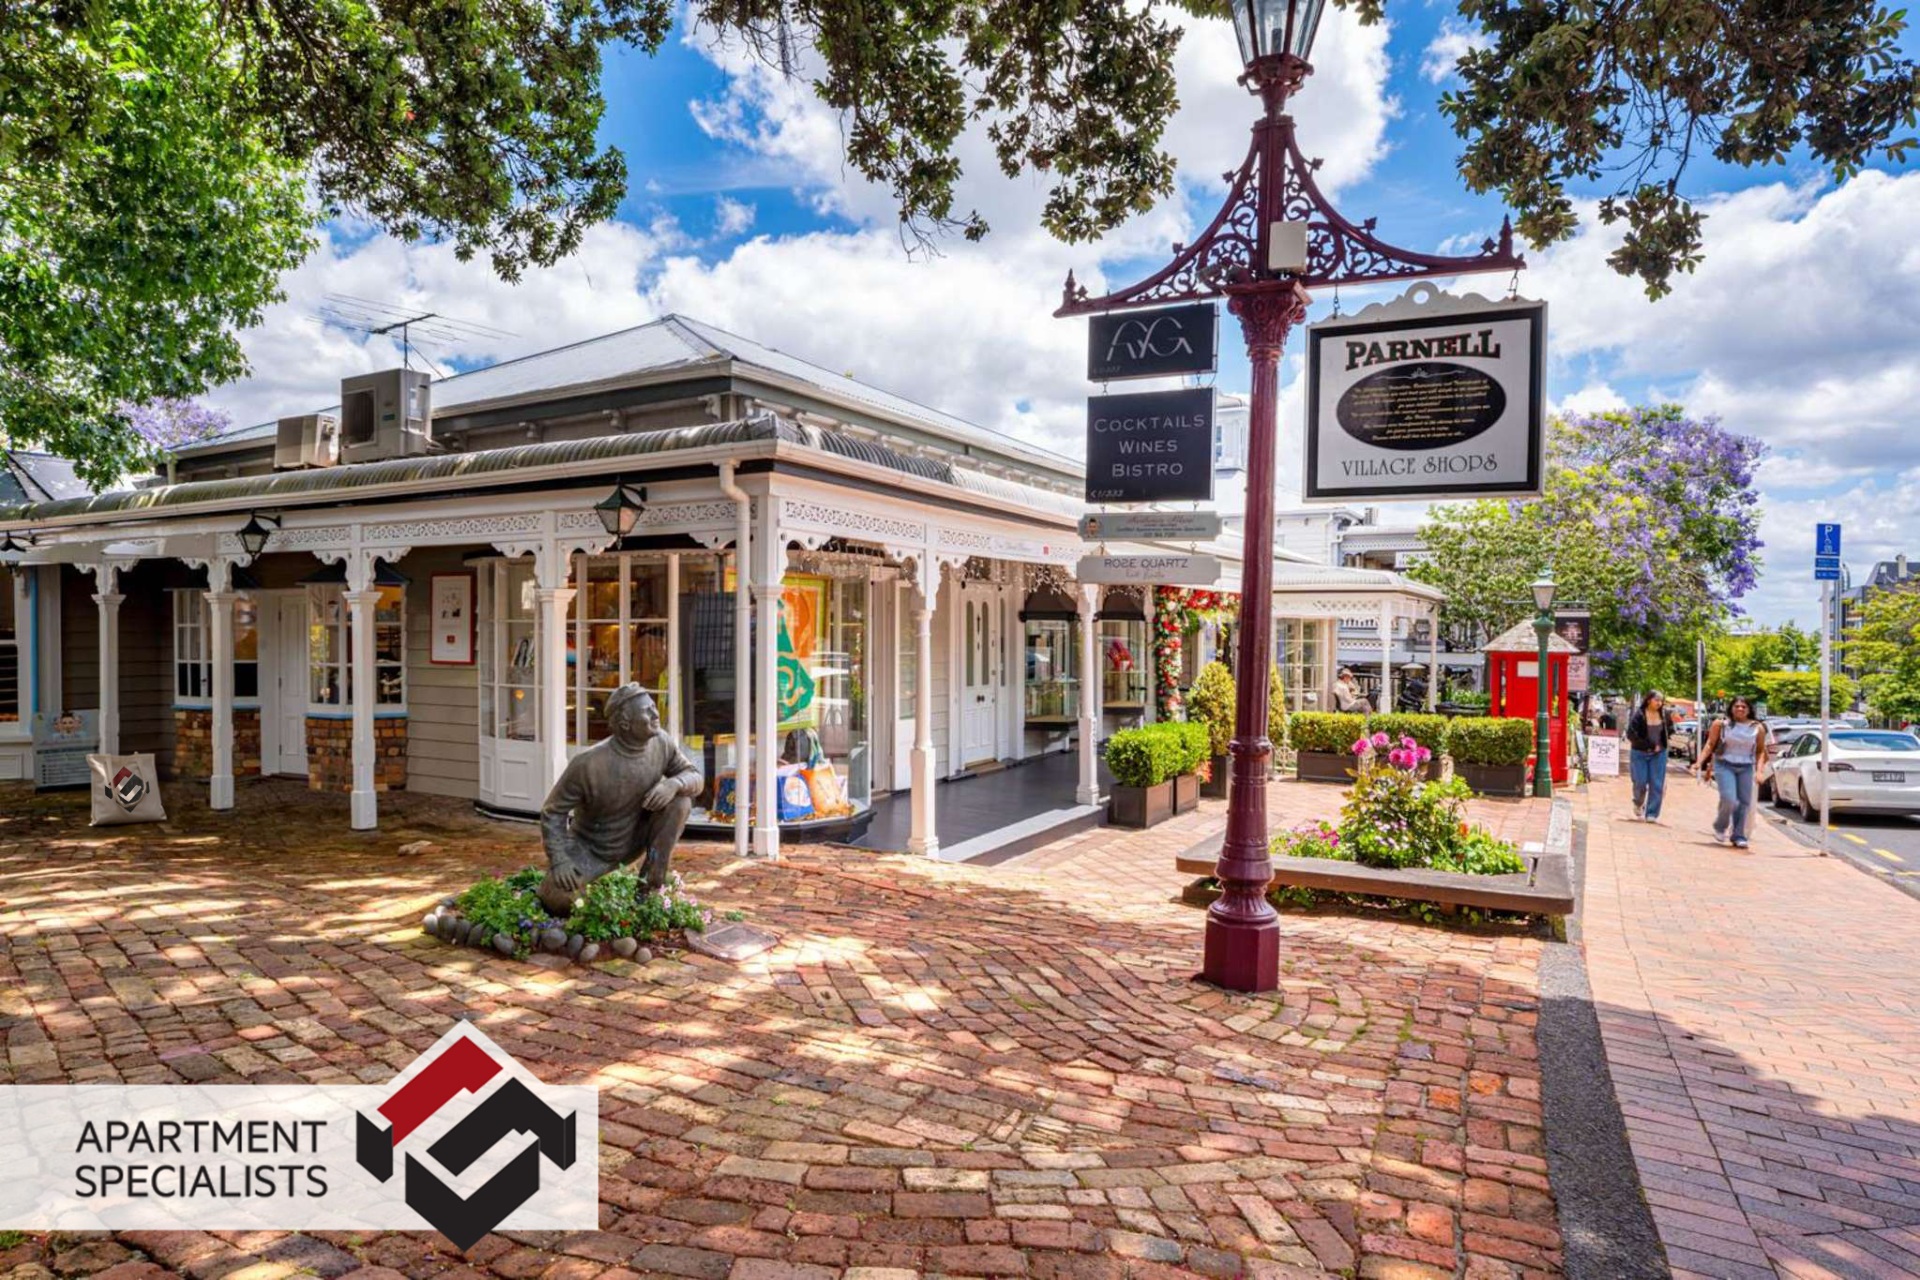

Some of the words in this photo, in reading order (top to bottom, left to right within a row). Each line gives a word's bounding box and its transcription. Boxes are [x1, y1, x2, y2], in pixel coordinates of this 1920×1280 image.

[1345, 329, 1501, 371] PARNELL
[1341, 457, 1416, 477] VILLAGE
[1423, 453, 1498, 474] SHOPS
[1141, 558, 1189, 569] QUARTZ
